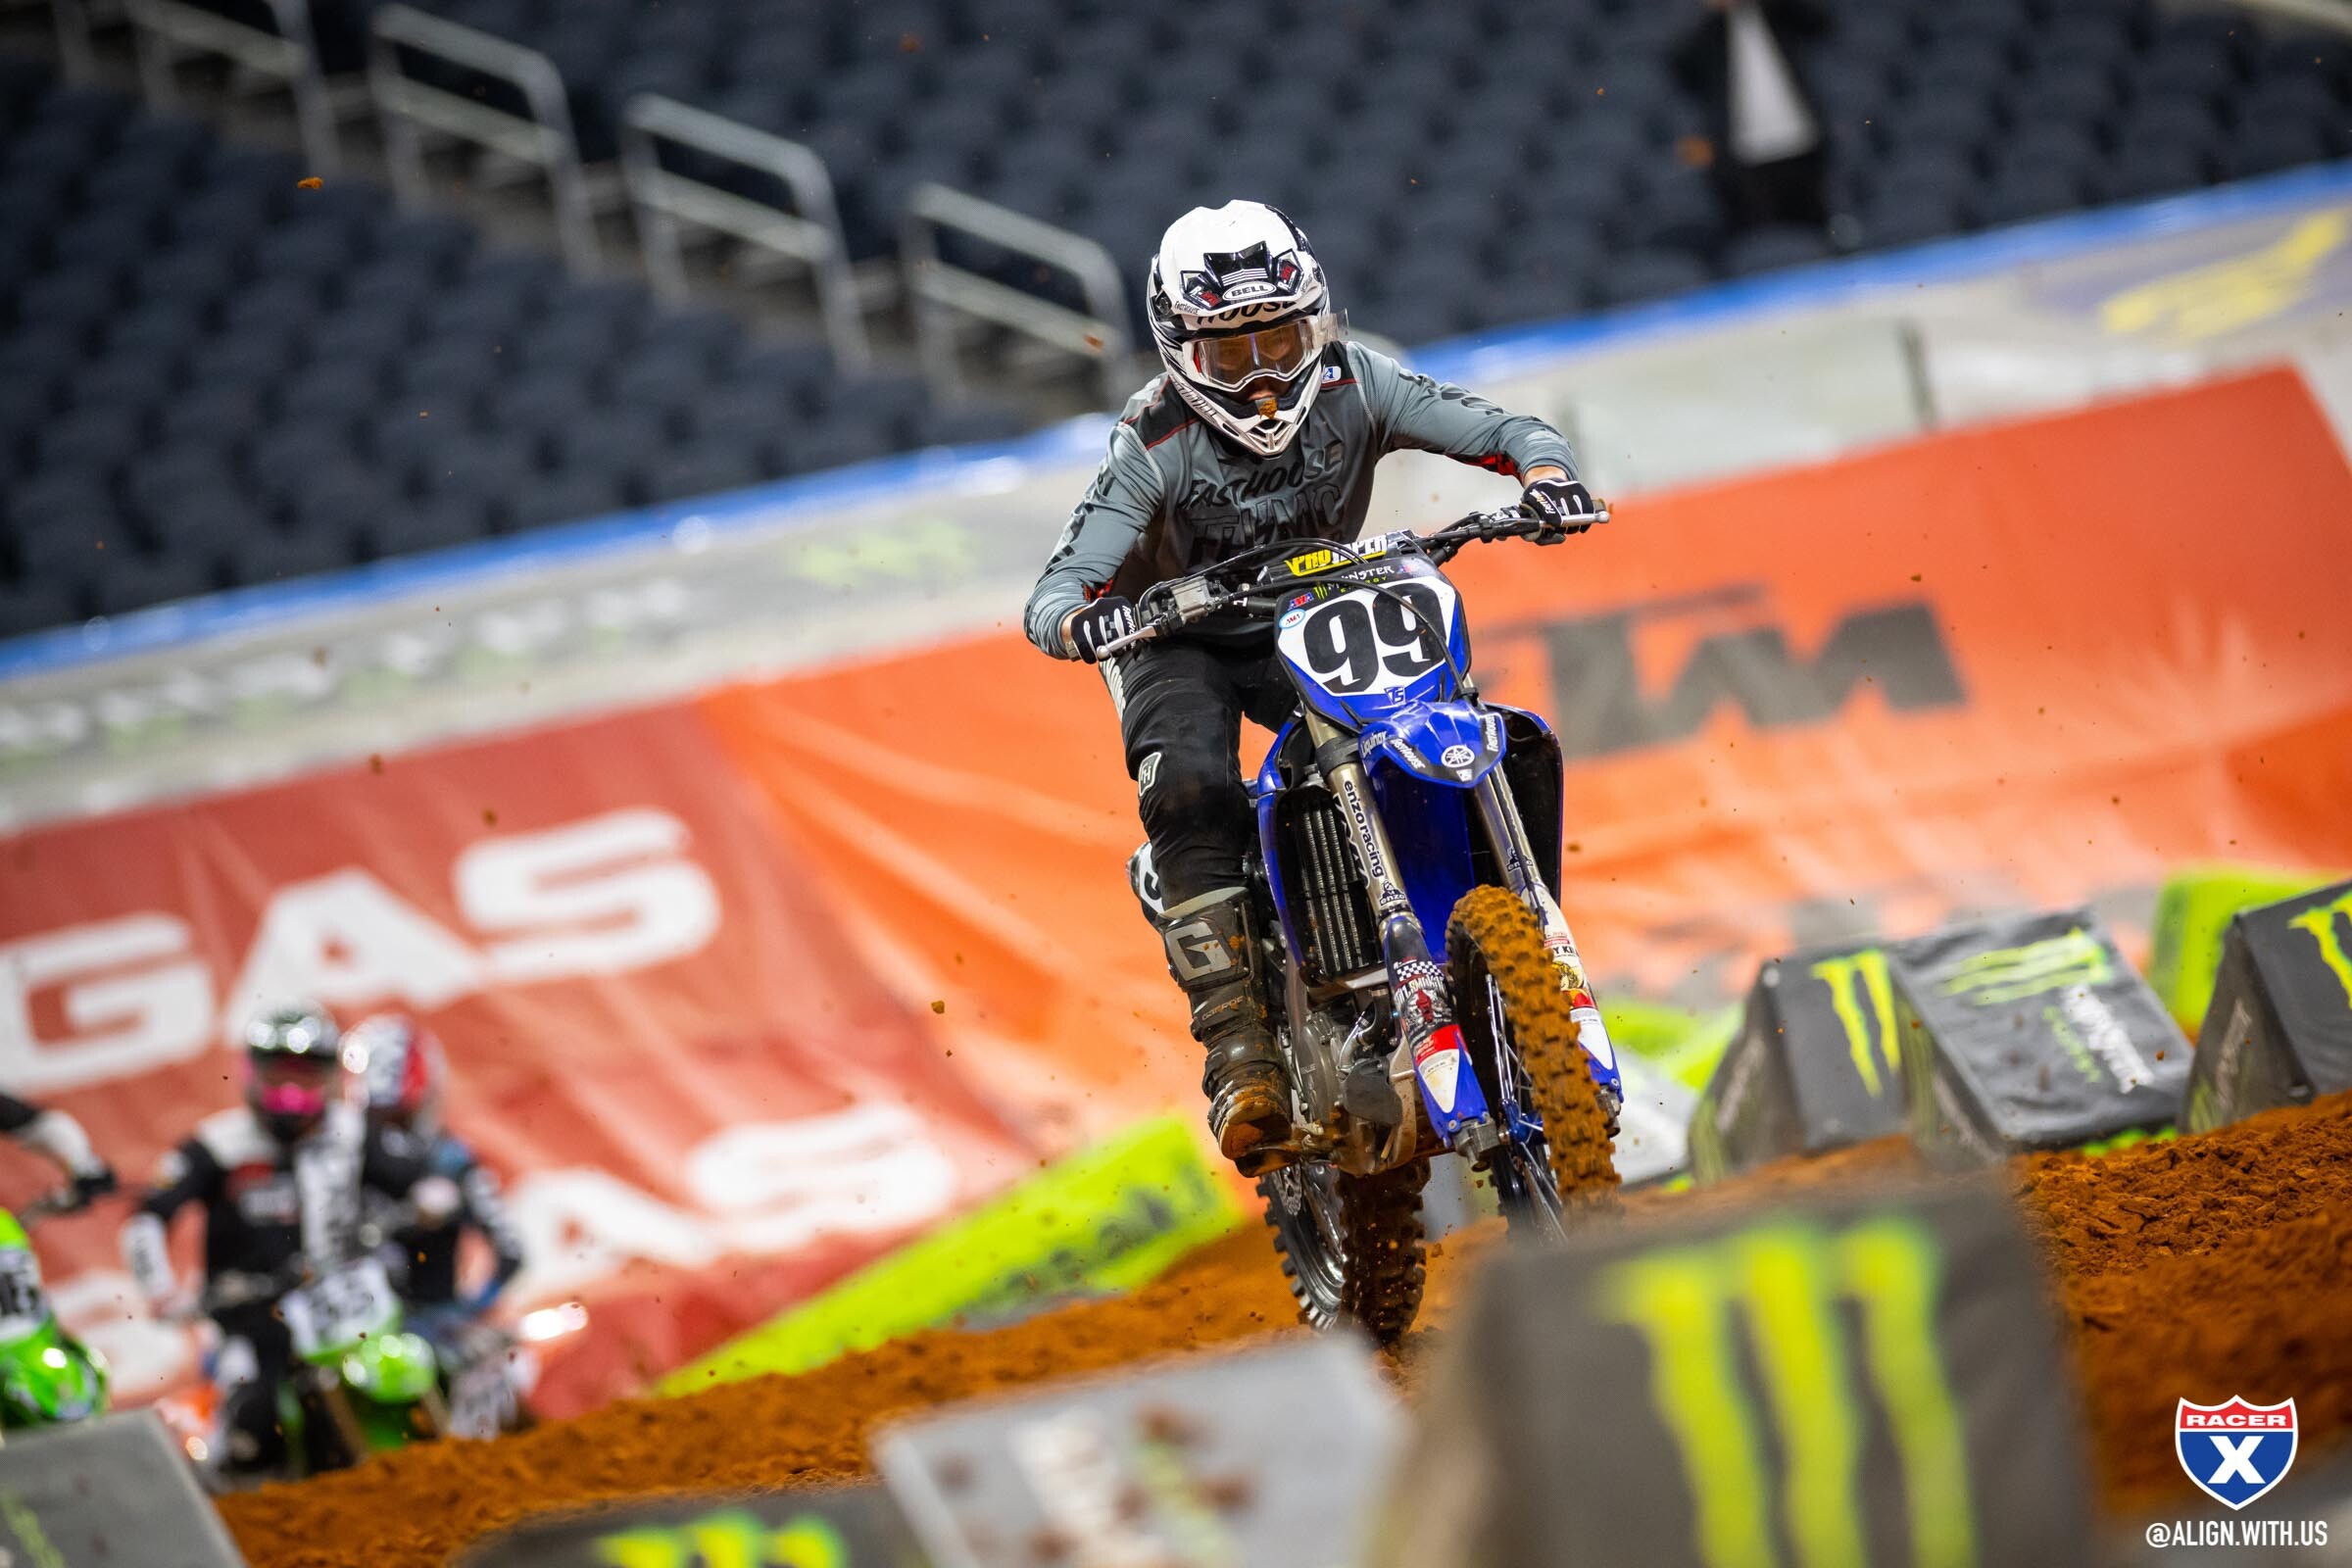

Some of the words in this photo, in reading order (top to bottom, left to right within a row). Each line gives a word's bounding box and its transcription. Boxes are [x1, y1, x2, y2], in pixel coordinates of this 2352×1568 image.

[1231, 284, 1270, 298] BELL
[1328, 565, 1396, 591] MNSTER
[1303, 582, 1447, 695] 99
[0, 807, 722, 1092] GAS
